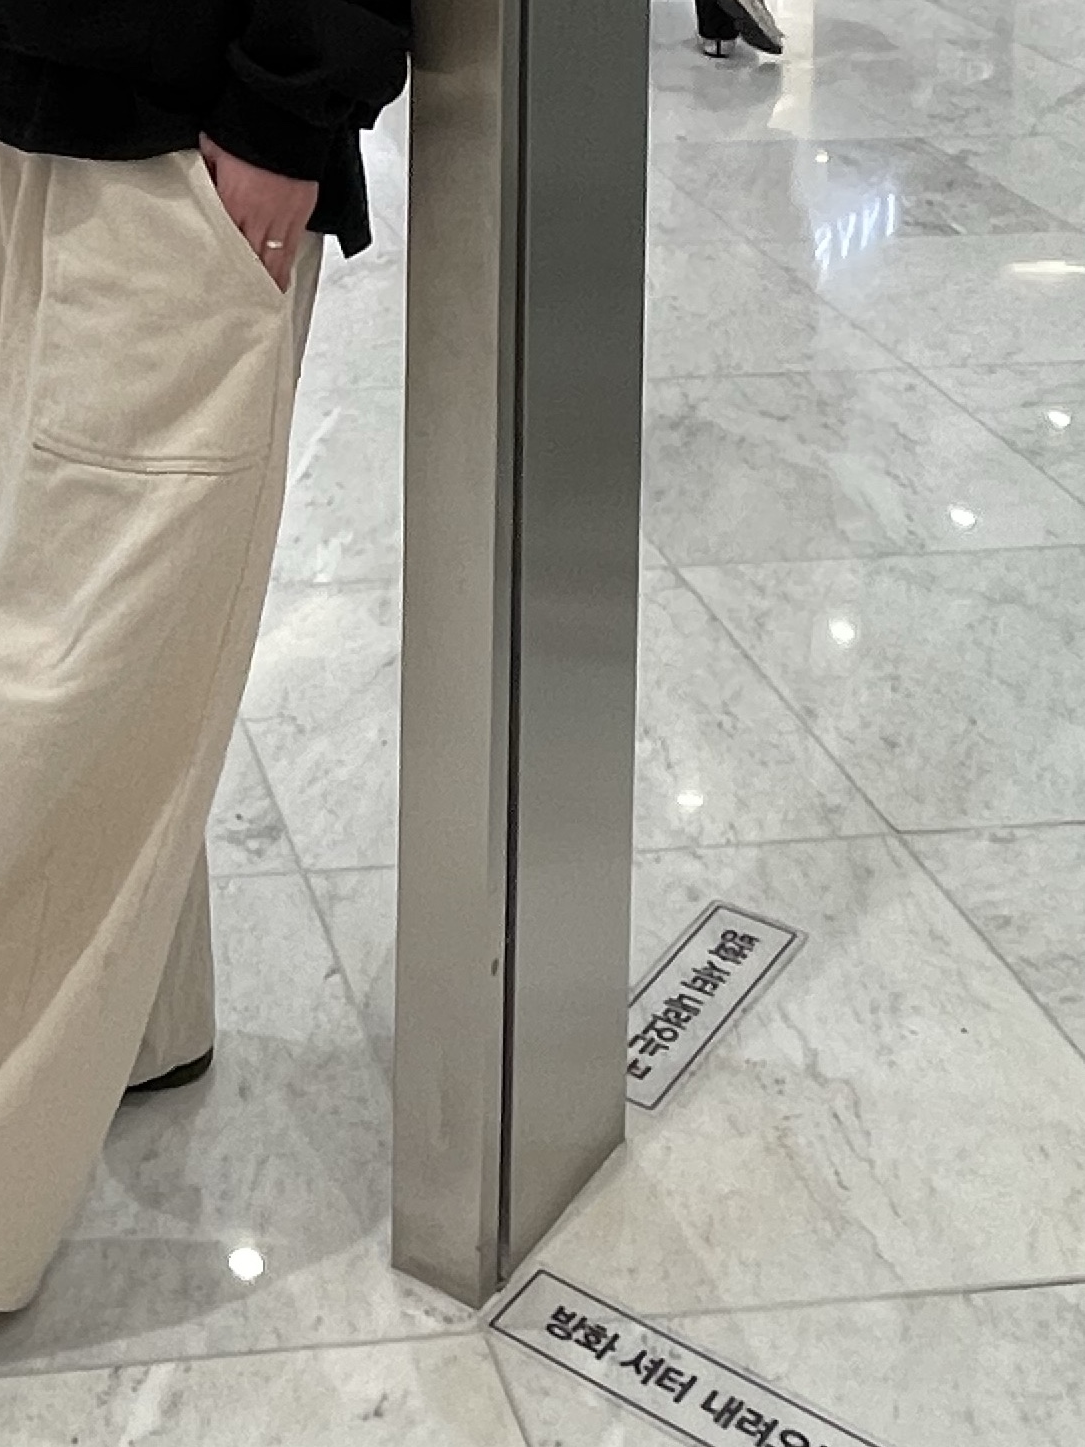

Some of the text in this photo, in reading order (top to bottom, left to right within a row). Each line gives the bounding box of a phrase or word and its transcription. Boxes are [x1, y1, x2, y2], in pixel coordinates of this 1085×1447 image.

[707, 929, 761, 966] 방화
[680, 960, 732, 997] 셔터
[628, 993, 704, 1057] 내려오는
[545, 1304, 620, 1361] 방화
[620, 1349, 698, 1404] 셔터
